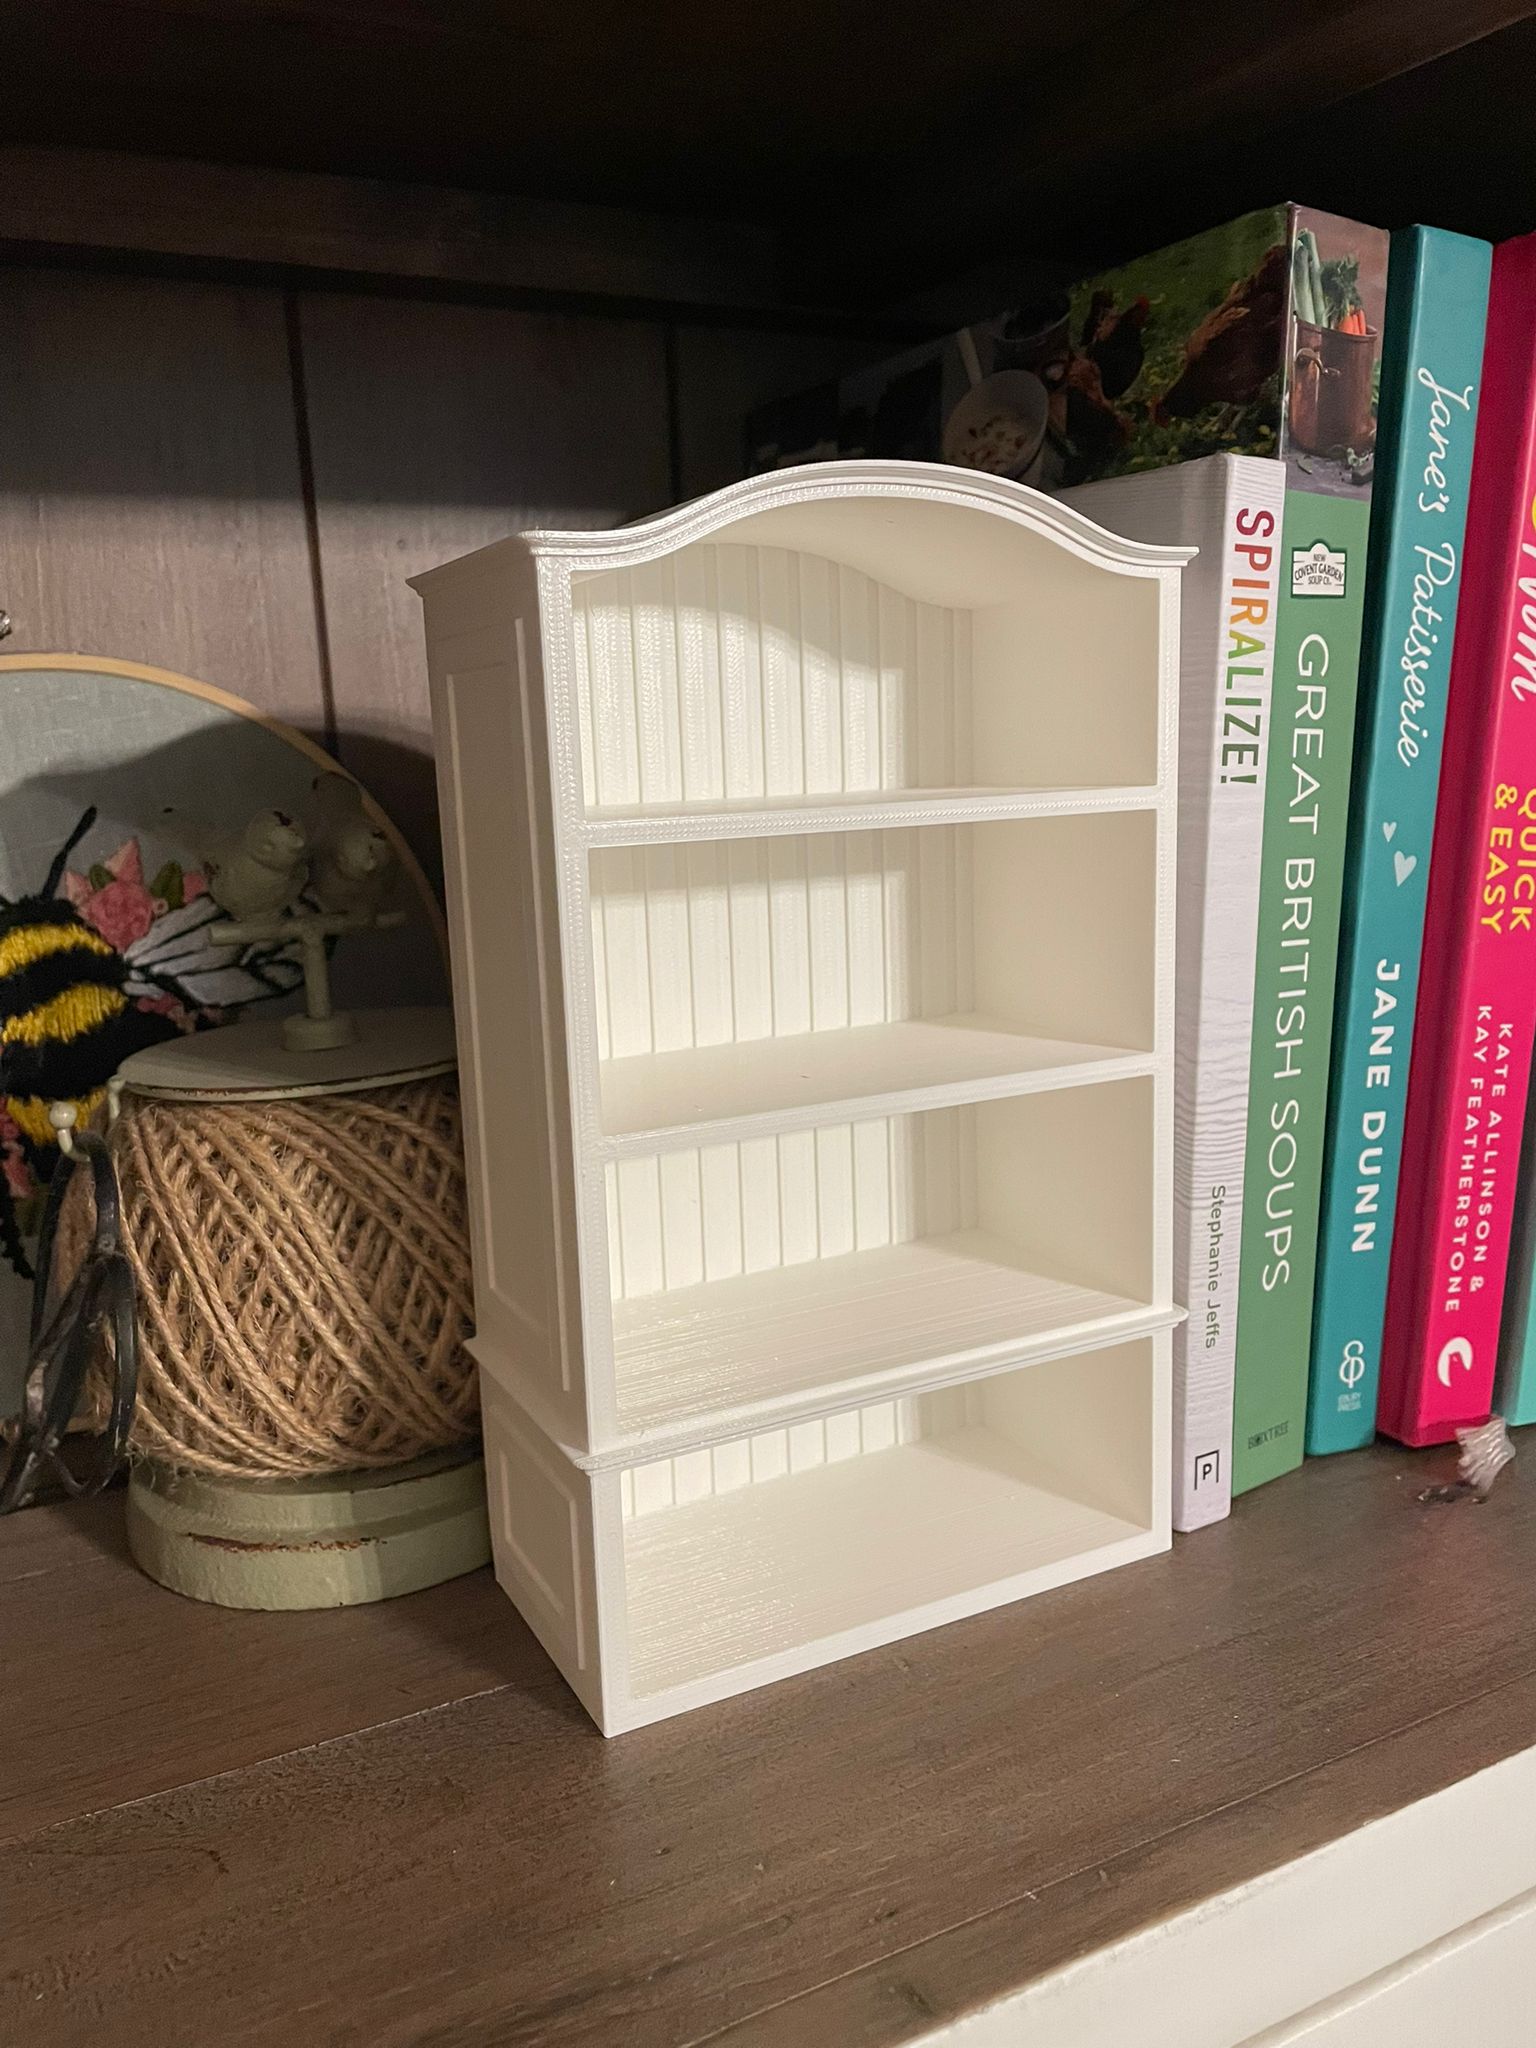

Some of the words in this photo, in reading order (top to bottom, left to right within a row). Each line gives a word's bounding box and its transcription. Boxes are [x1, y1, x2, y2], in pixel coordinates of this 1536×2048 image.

[1417, 367, 1474, 513] Jane's
[1294, 563, 1318, 581] COVENT
[1318, 563, 1343, 582] GARDEN
[1308, 575, 1323, 585] SOUP
[1220, 508, 1275, 784] SPIRALIZE!
[1397, 543, 1456, 767] Patisserie
[1288, 634, 1329, 835] GREAT
[1494, 783, 1518, 810] &
[1480, 827, 1514, 934] EASY
[1273, 858, 1315, 1079] BRITISH
[1366, 959, 1401, 1088] JANE
[1472, 1005, 1492, 1062] KAY
[1491, 1023, 1514, 1097] KATE
[1207, 1185, 1226, 1291] Stephanie
[1262, 1099, 1299, 1291] SOUPS
[1351, 1111, 1387, 1252] DUNN
[1445, 1078, 1484, 1312] FEATHERSTONE
[1473, 1110, 1503, 1262] ALLINSON
[1205, 1300, 1221, 1348] Jeffs
[1469, 1276, 1485, 1292] &
